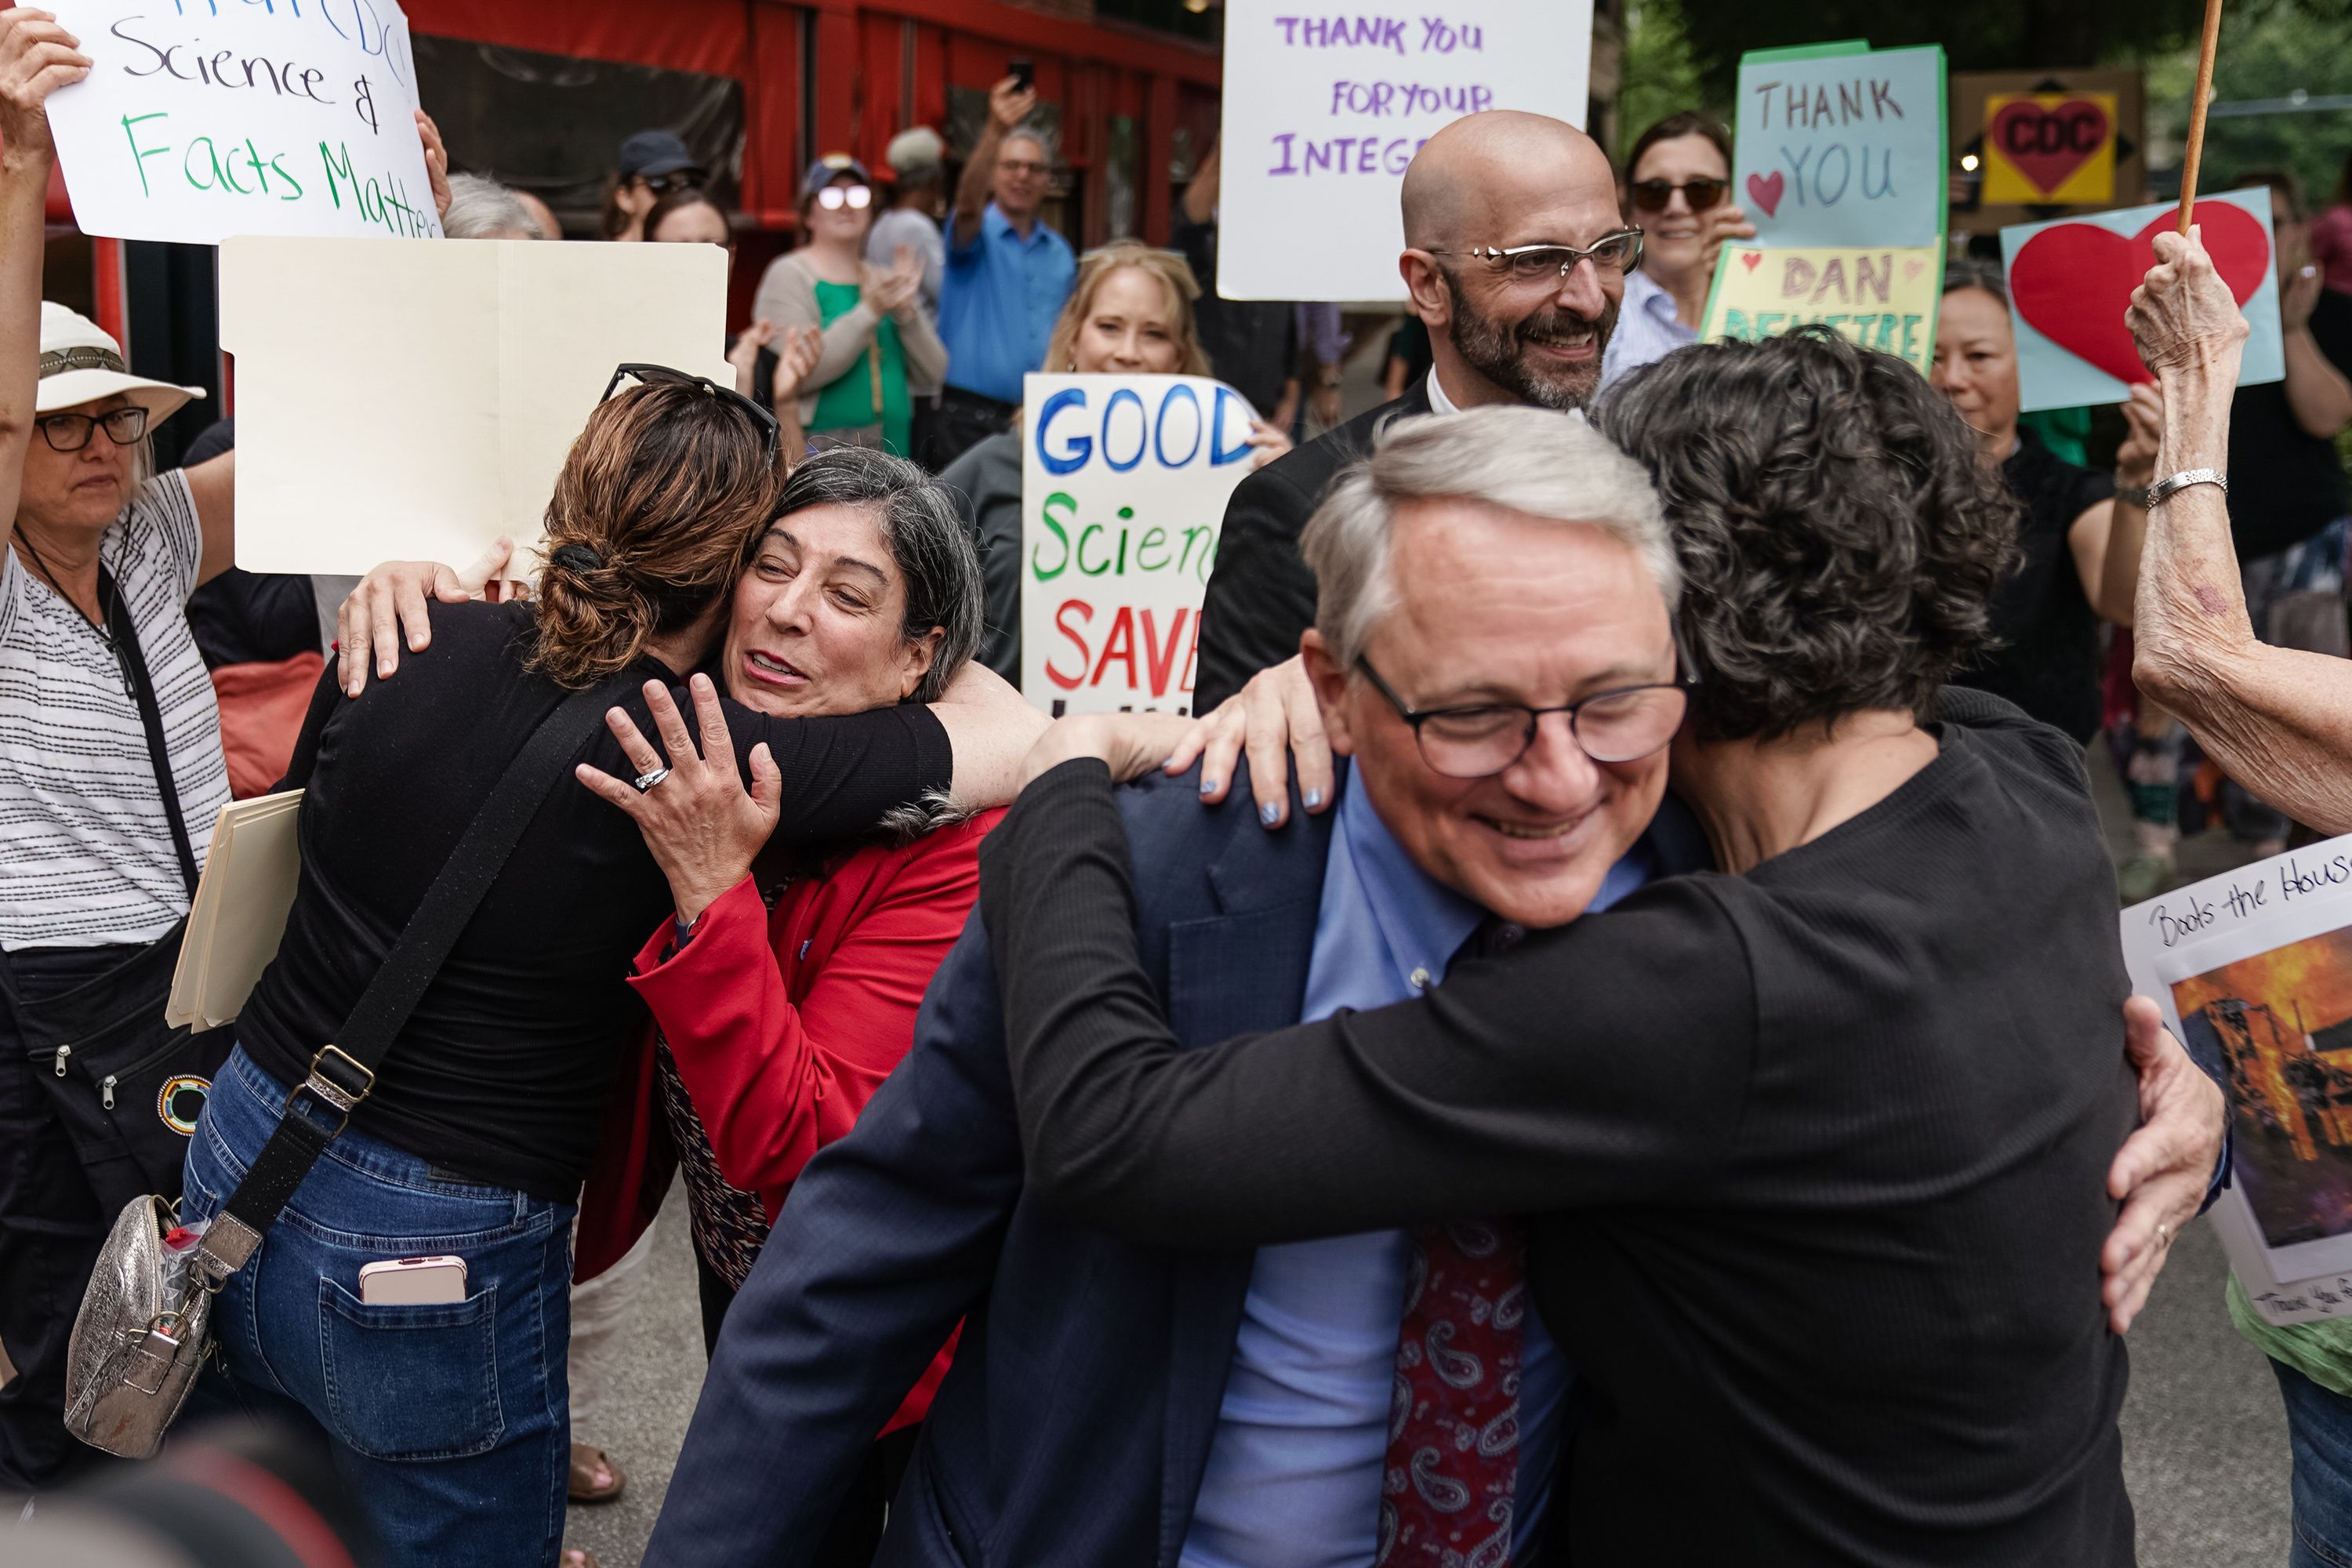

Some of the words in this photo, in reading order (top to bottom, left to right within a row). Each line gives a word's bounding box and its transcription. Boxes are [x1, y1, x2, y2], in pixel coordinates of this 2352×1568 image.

[1276, 16, 1406, 55] THANK
[1421, 17, 1483, 53] YOU
[111, 16, 336, 104] Science
[354, 74, 379, 135] &
[1755, 78, 1904, 130] THANK
[1268, 132, 1428, 176] INTEG
[2005, 113, 2098, 155] CDC
[121, 112, 303, 200] Facts
[319, 140, 437, 238] Matter
[1780, 142, 1898, 208] YOU
[1780, 254, 1893, 305] DAN
[1036, 383, 1256, 476] GOOD
[1032, 492, 1219, 587] Scien
[2220, 880, 2268, 918] the
[2280, 855, 2352, 901] Hous
